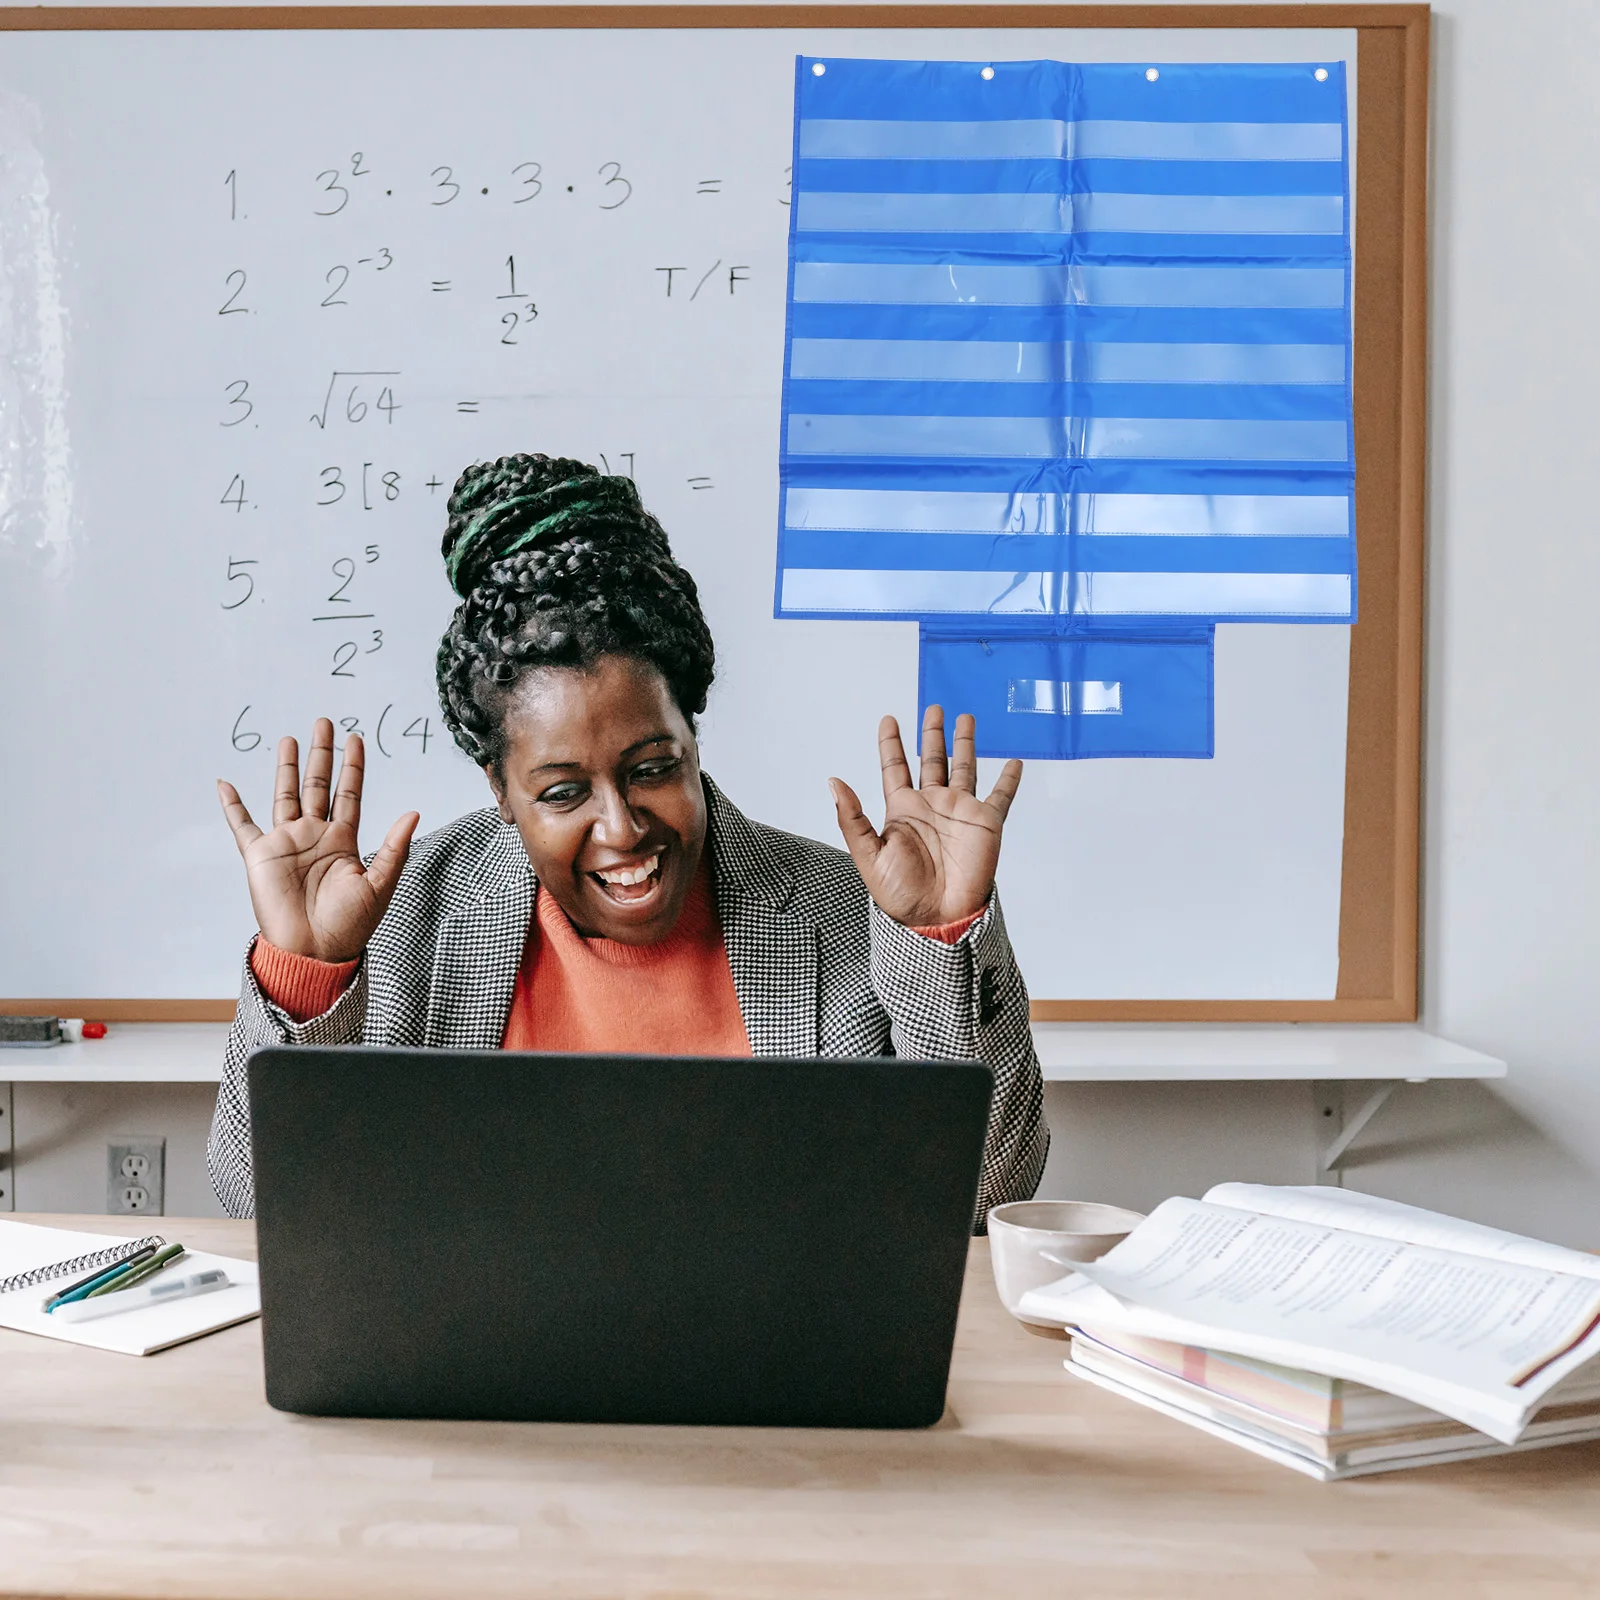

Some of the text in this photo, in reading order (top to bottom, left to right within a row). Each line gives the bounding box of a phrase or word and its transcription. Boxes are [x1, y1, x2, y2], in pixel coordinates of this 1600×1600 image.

[225, 169, 249, 220] 1.
[431, 166, 460, 205] 3
[512, 162, 542, 203] 3
[598, 162, 632, 209] 3
[218, 270, 258, 315] 2.
[220, 380, 259, 428] 3.
[220, 474, 259, 513] 4.
[221, 556, 265, 610] 5.
[232, 705, 271, 752] 6.
